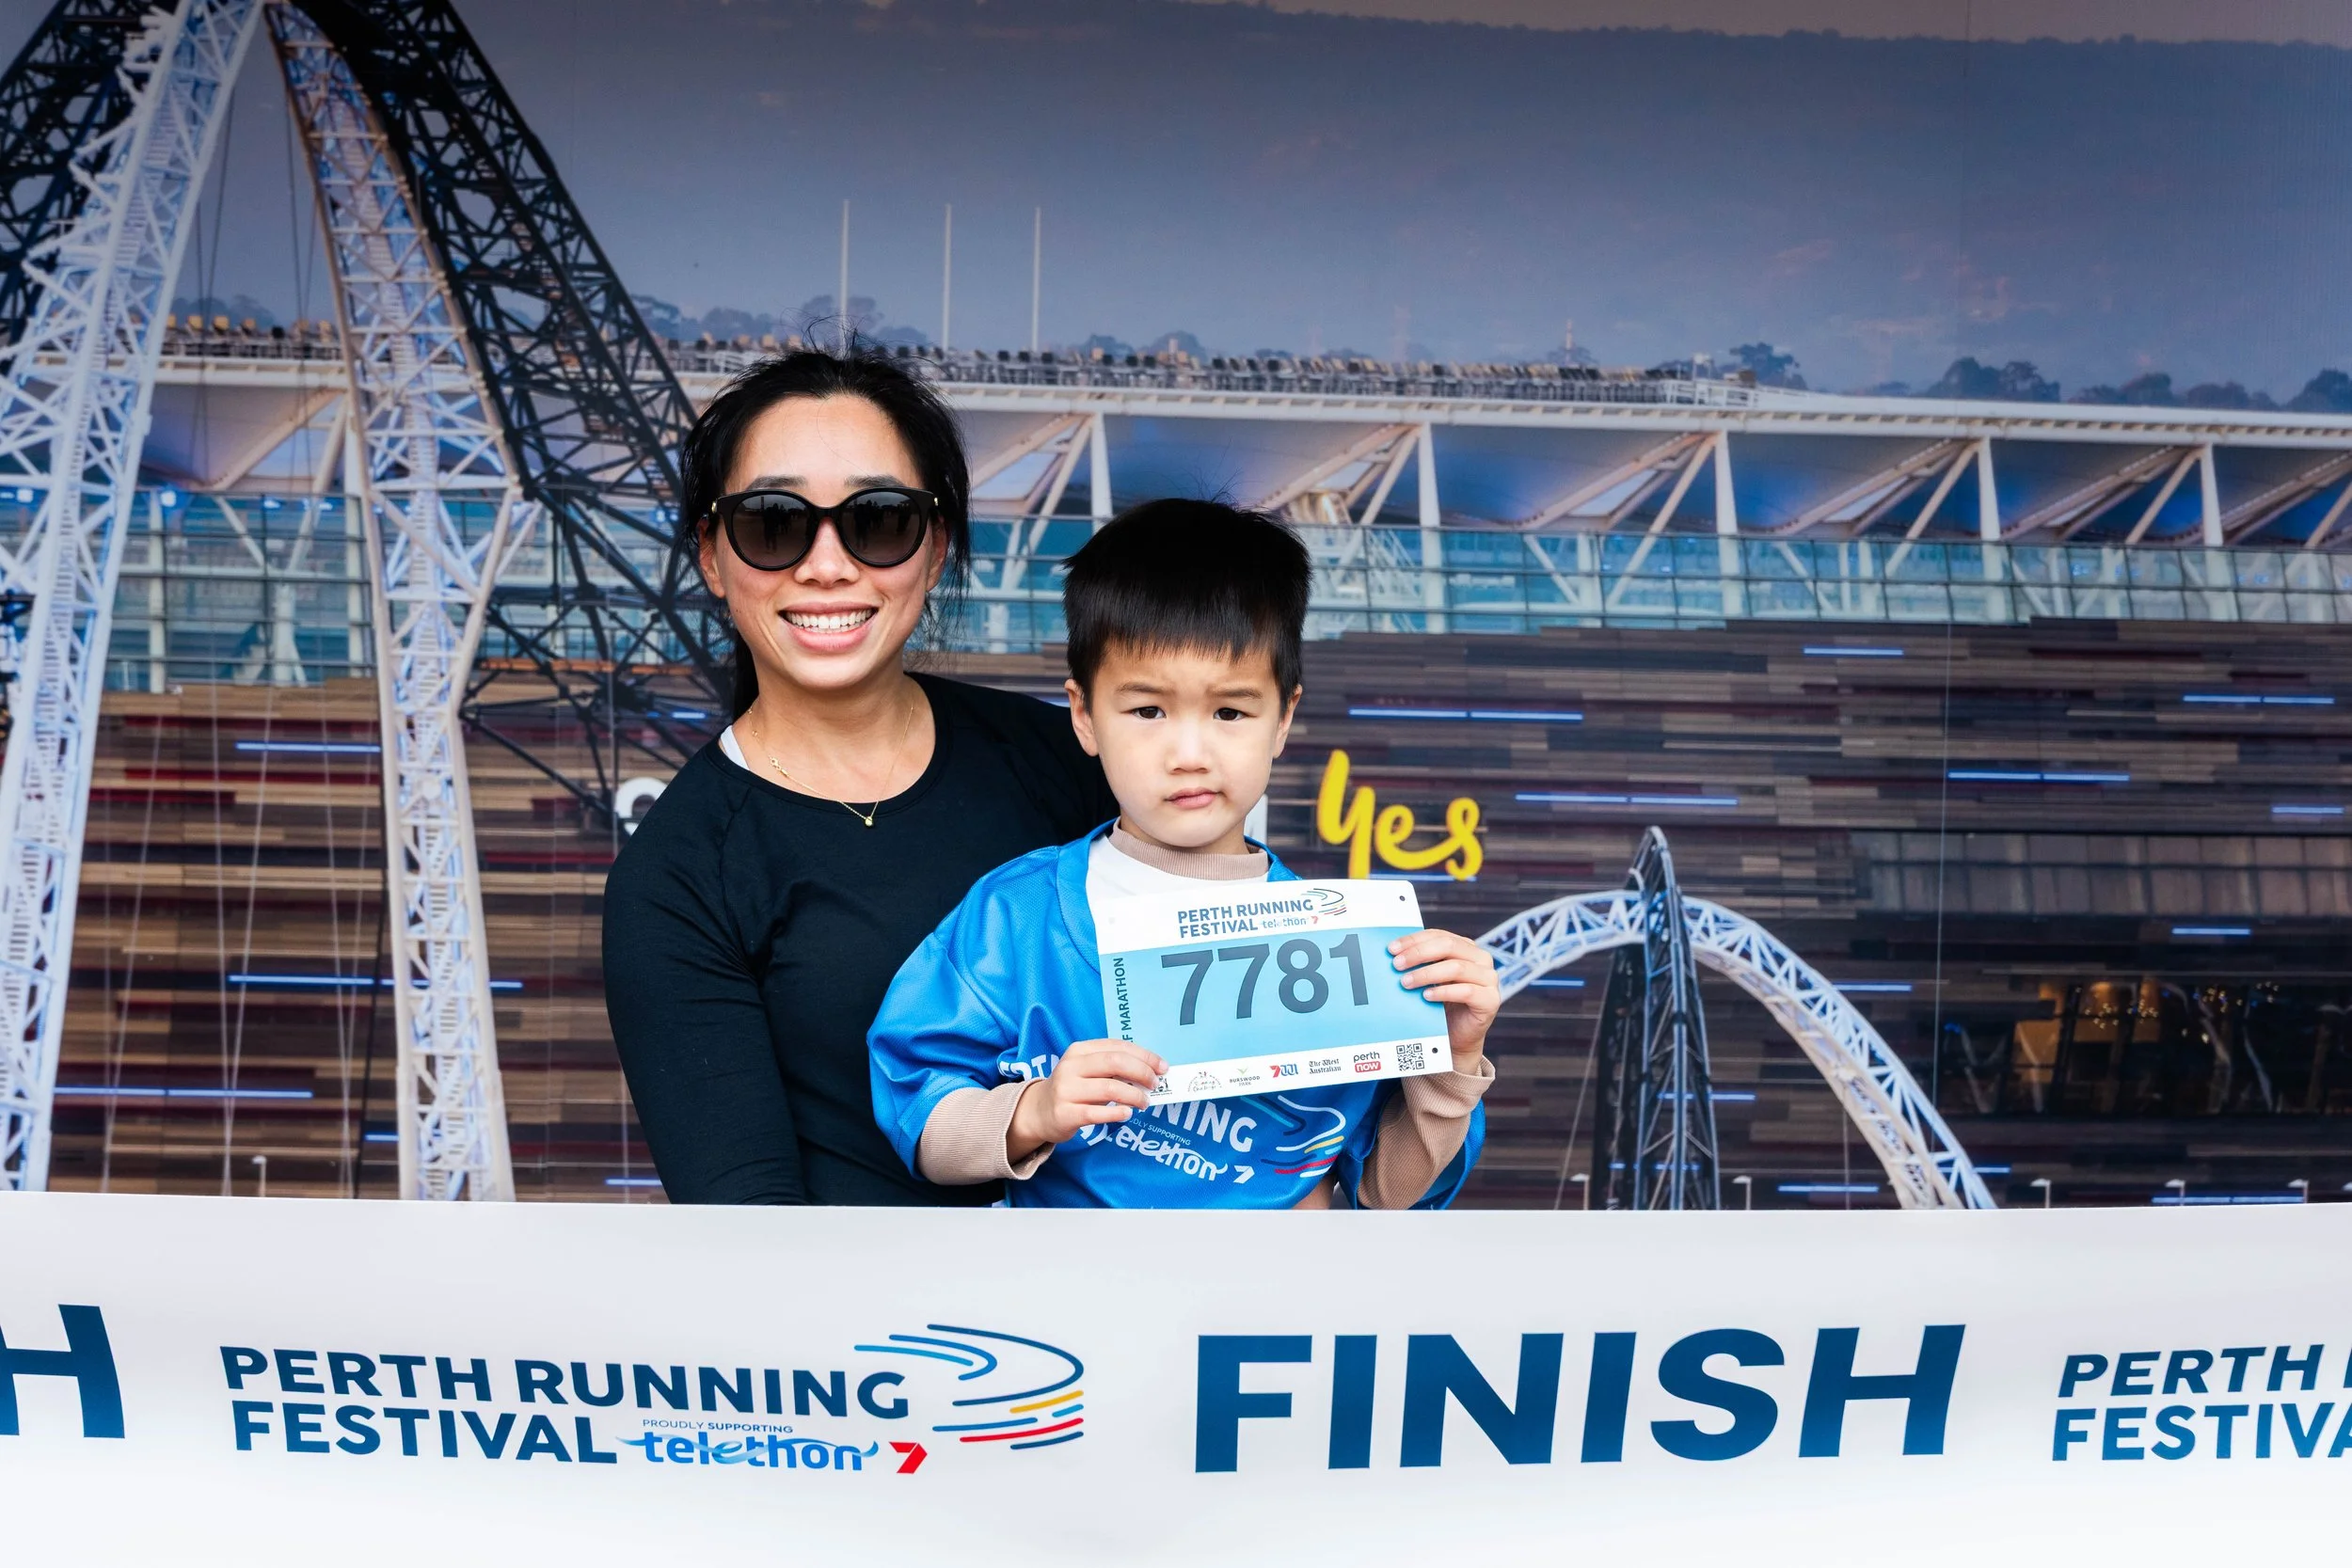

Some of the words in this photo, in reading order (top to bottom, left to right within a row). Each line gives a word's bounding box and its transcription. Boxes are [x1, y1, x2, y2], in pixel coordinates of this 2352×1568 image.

[1178, 906, 1232, 924] PERTH
[1236, 899, 1313, 917] RUNNING
[1180, 918, 1258, 939] FESTIVAL
[1113, 958, 1132, 1031] MARATHON
[1160, 933, 1369, 1026] 7781
[1309, 1066, 1342, 1075] Australian
[1353, 1052, 1380, 1063] perth
[1356, 1062, 1379, 1072] now
[1115, 1125, 1226, 1181] elethon
[1148, 1124, 1191, 1146] SUPPORTING
[219, 1346, 492, 1402] PERTH
[515, 1359, 909, 1419] RUNNING
[2058, 1343, 2325, 1398] PERTH
[1194, 1323, 1966, 1473] FINISH
[231, 1400, 617, 1465] FESTIVAL
[643, 1418, 705, 1430] PROUDLY
[707, 1421, 794, 1433] SUPPORTING
[644, 1431, 864, 1471] telethon
